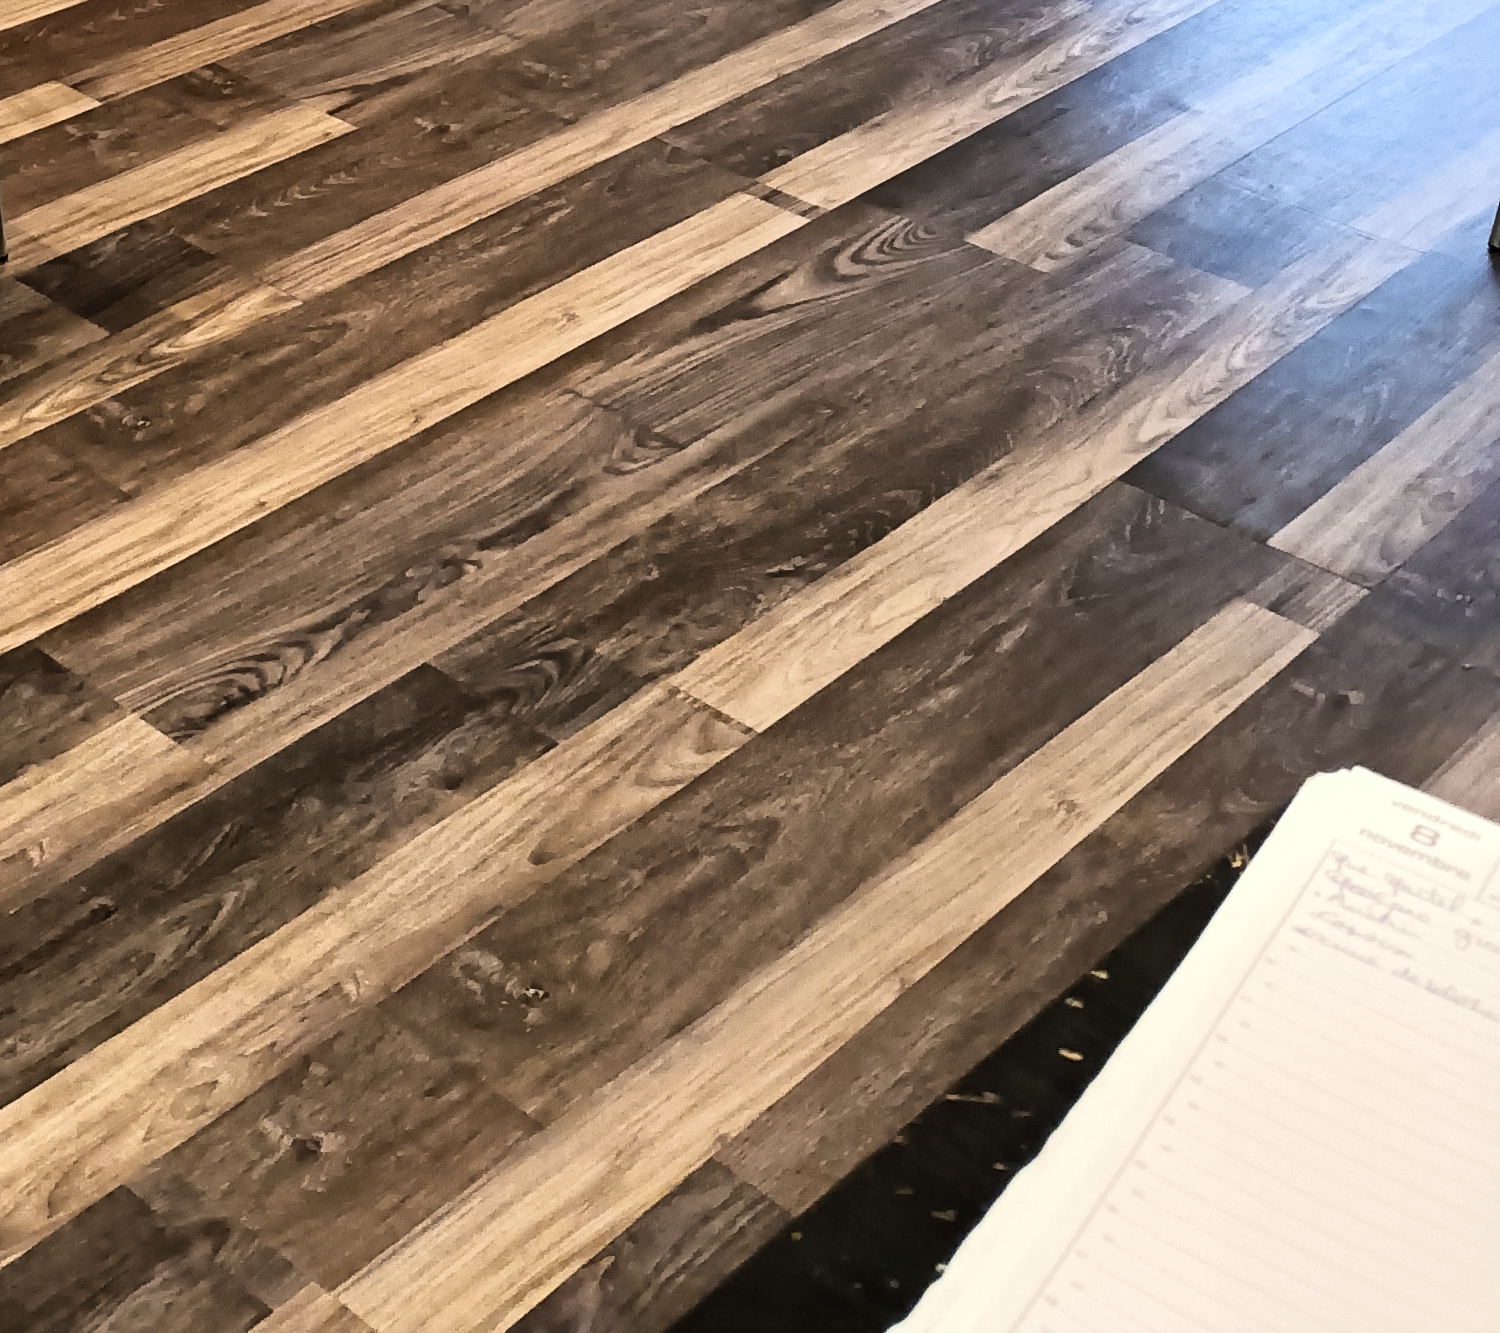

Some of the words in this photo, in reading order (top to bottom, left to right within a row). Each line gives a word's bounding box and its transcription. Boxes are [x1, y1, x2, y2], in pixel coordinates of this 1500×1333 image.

[1391, 799, 1481, 841] vendredi
[1410, 824, 1440, 847] 8
[1358, 828, 1471, 880] novembre
